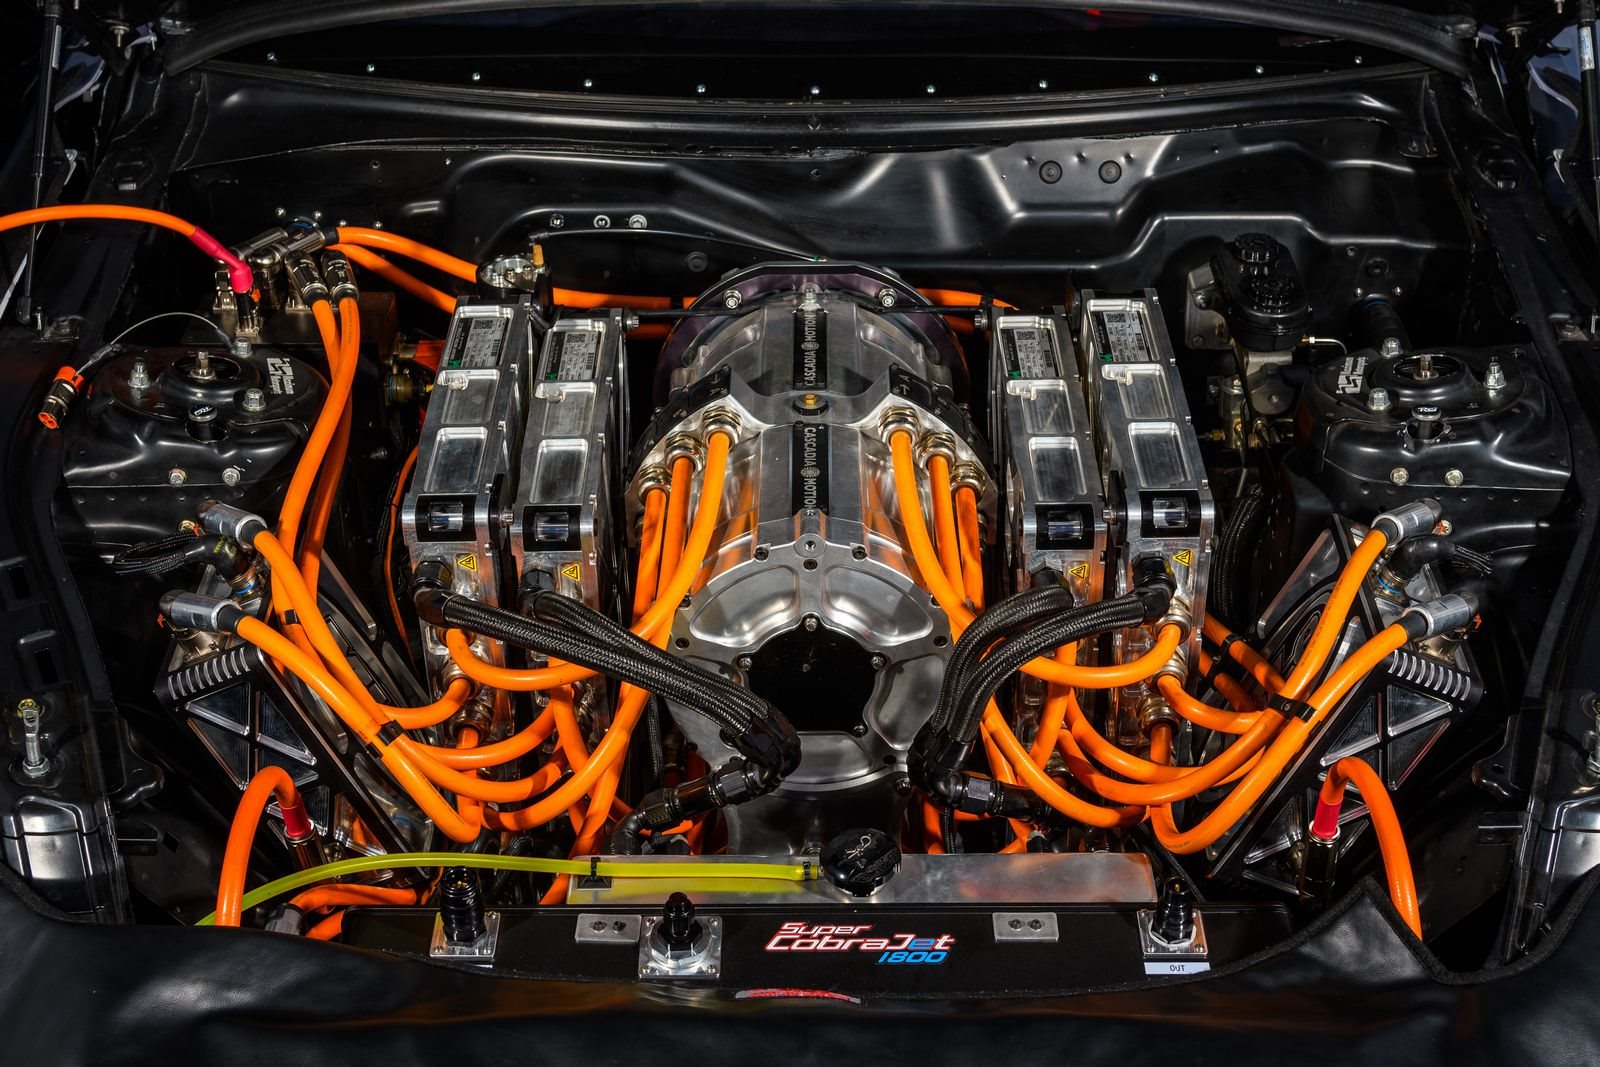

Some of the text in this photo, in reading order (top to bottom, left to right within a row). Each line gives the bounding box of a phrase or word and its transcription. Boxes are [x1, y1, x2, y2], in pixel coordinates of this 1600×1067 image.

[804, 314, 817, 386] CASCADIA MOTION
[804, 427, 817, 466] CASCADIA
[779, 921, 873, 938] Super
[876, 951, 948, 963] 1800
